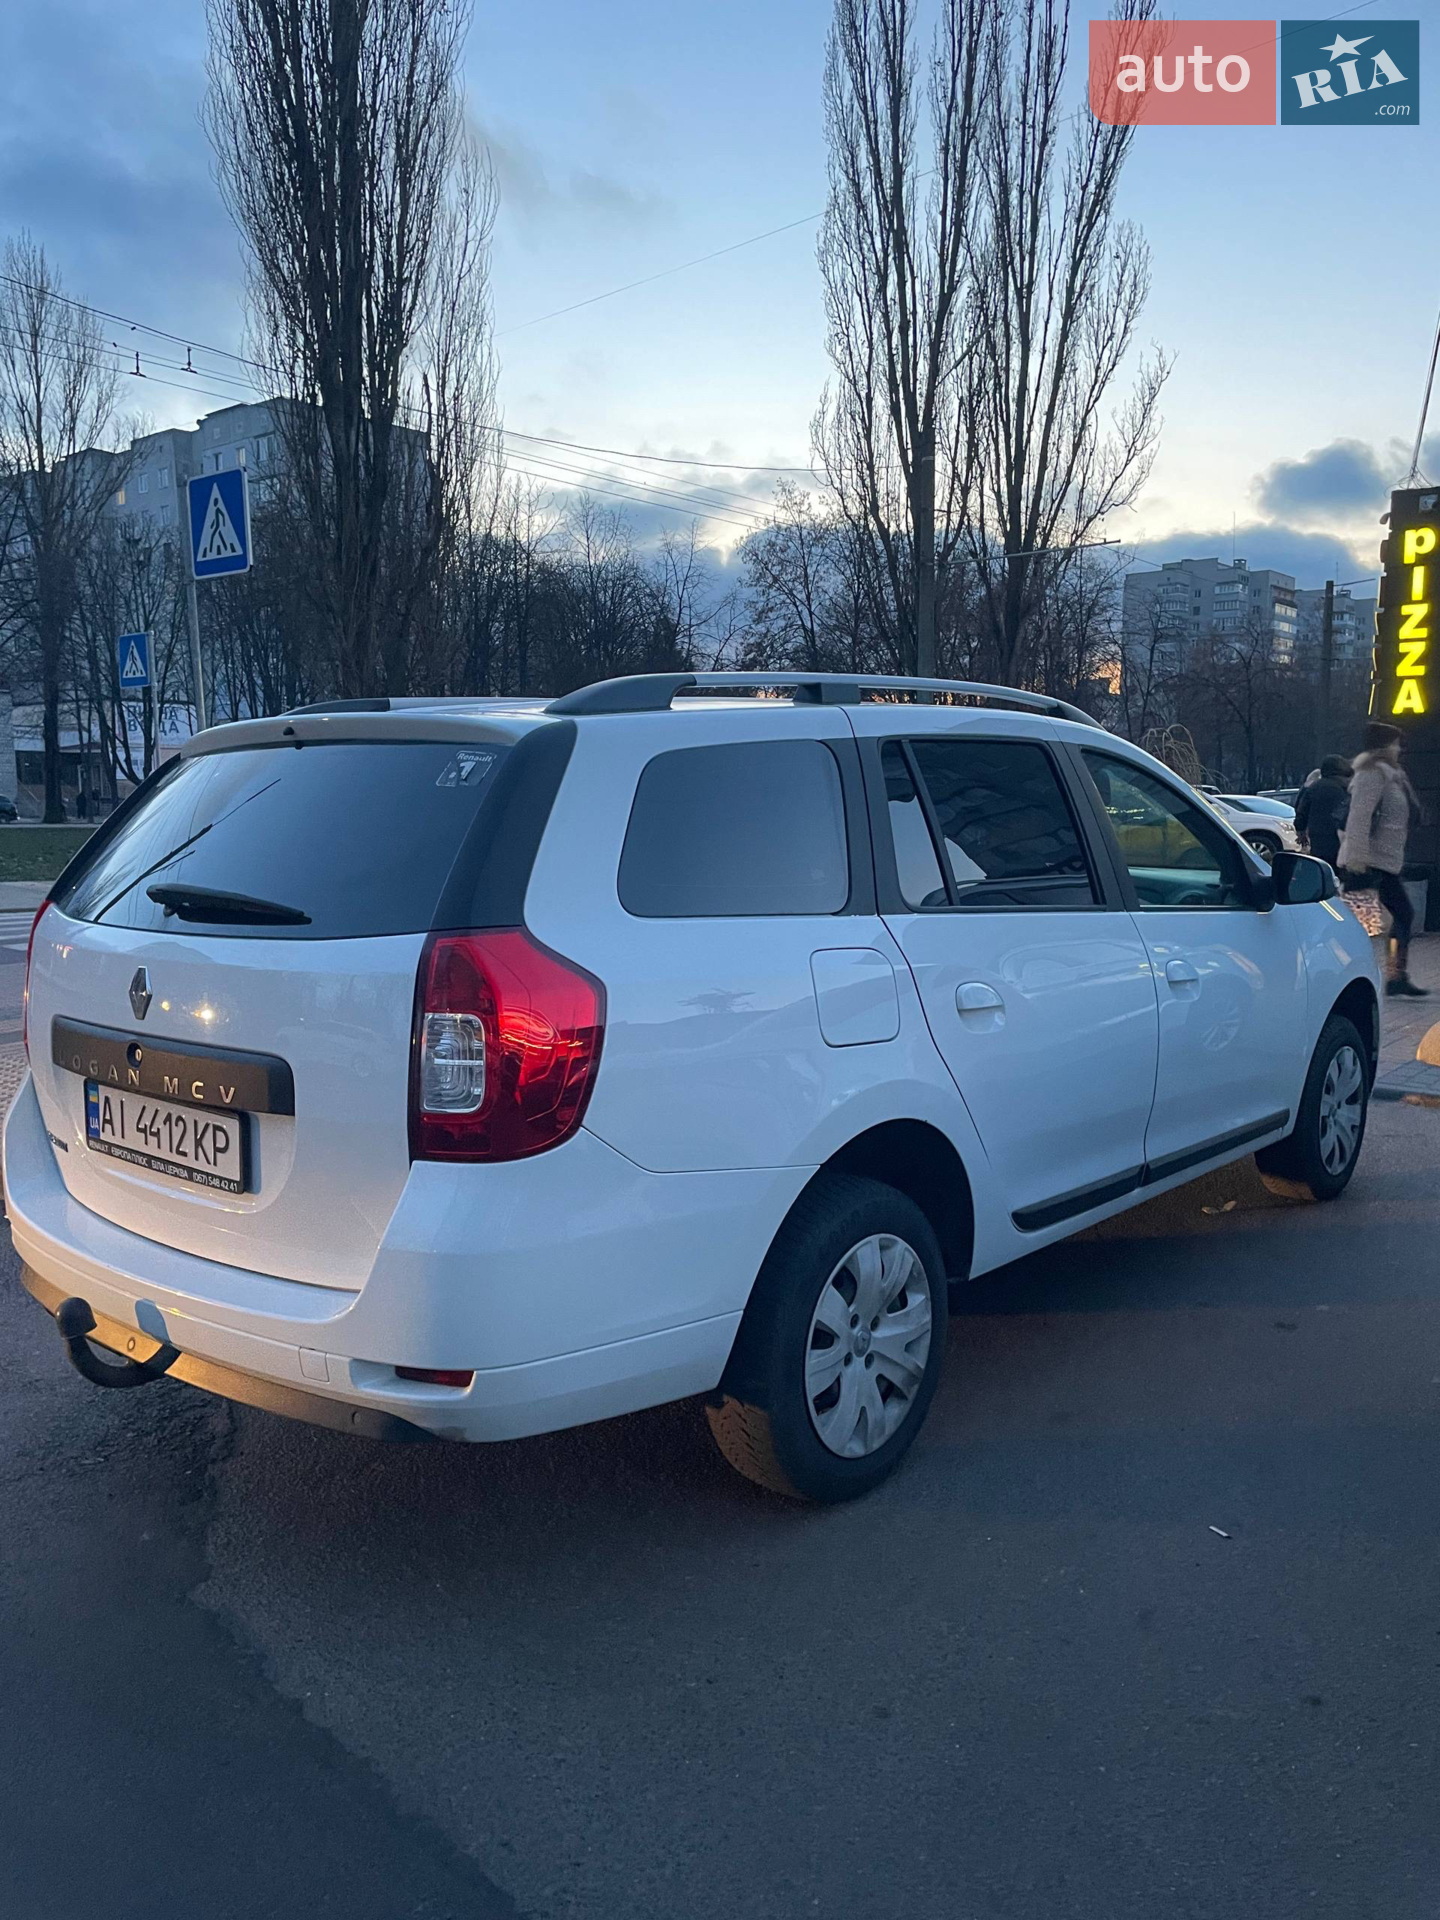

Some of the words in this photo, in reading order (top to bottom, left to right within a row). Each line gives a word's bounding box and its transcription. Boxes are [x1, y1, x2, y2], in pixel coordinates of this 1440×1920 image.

[457, 753, 492, 762] Renault
[163, 1076, 236, 1104] MCV
[89, 1117, 99, 1130] UA
[101, 1095, 125, 1139] AI
[136, 1104, 188, 1158] 4412
[193, 1118, 230, 1167] KP
[165, 1164, 189, 1179] ЦЕРКВА
